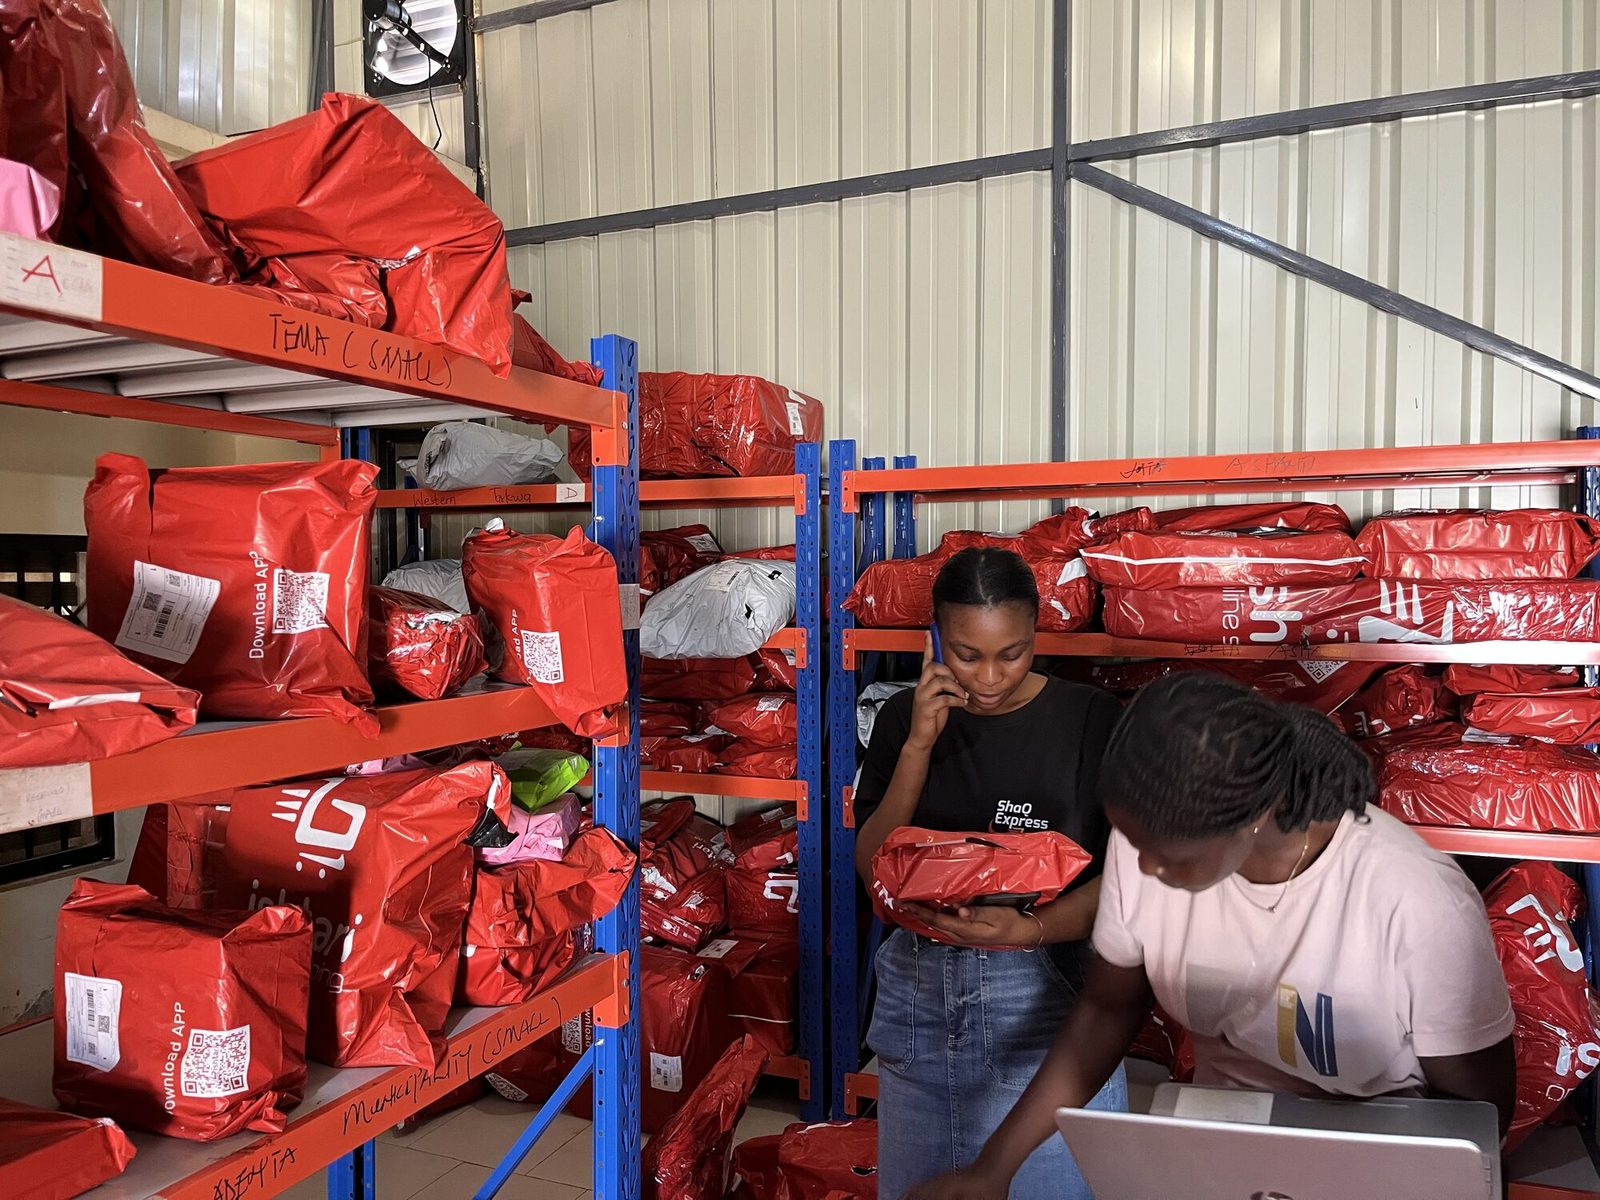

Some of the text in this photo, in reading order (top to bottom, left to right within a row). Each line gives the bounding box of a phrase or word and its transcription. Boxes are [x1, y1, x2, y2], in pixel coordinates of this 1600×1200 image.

[21, 254, 61, 292] A
[269, 314, 330, 356] TEMA
[412, 491, 457, 507] Western
[249, 550, 269, 659] Download APP
[511, 609, 520, 635] APP
[994, 812, 1049, 830] Express
[996, 799, 1033, 818] ShaQ
[161, 1001, 186, 1114] ownload APP
